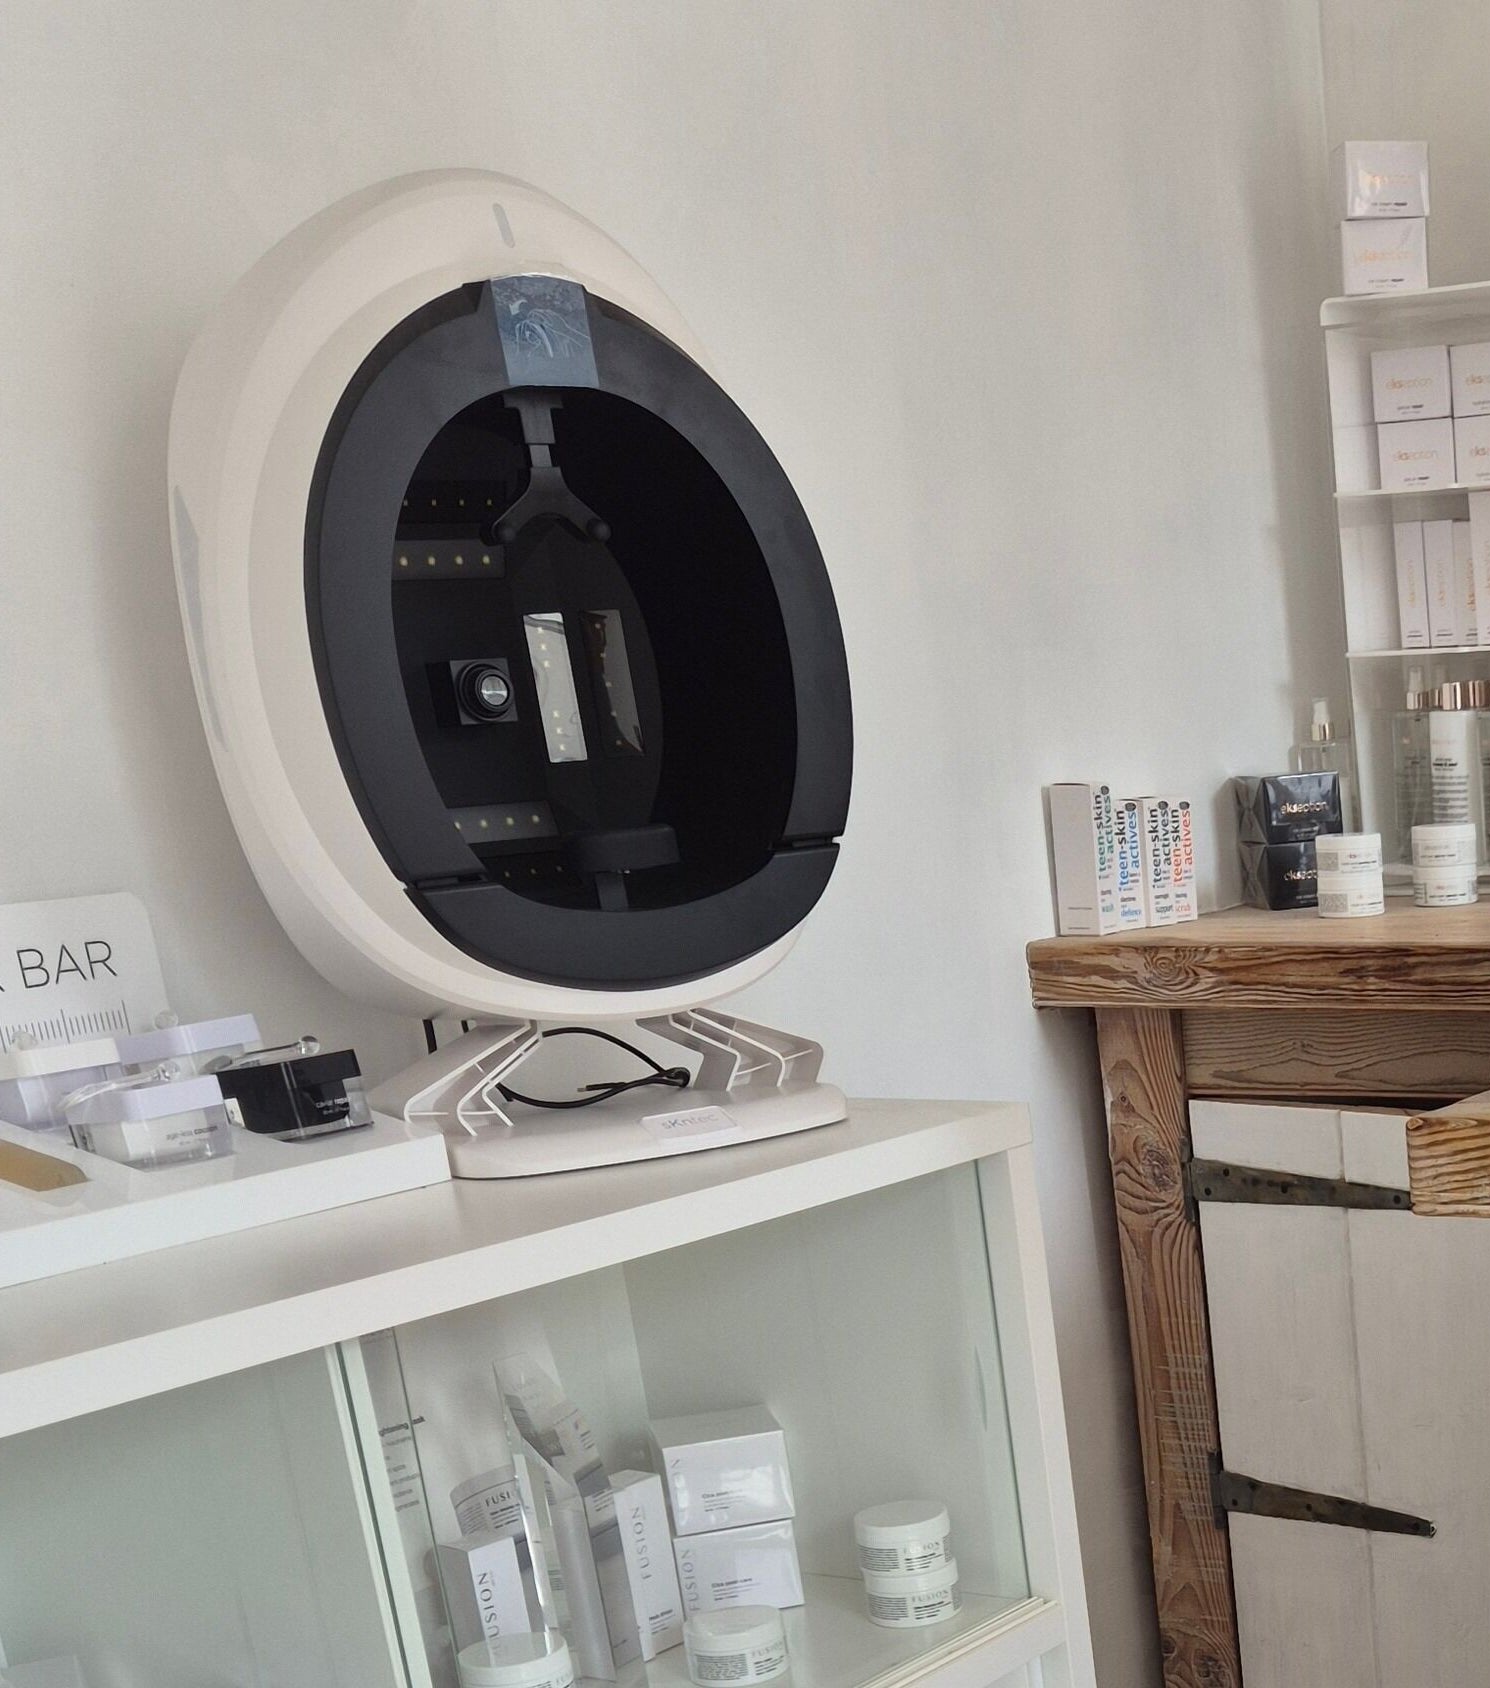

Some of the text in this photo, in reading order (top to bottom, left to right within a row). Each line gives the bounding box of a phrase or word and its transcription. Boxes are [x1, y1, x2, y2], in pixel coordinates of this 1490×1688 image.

[1103, 794, 1114, 854] actives
[1114, 810, 1129, 886] teen-skin
[1127, 810, 1140, 869] actives
[1148, 808, 1162, 883] teen-skin
[1158, 809, 1172, 866] actives
[1171, 809, 1183, 883] teen-skin
[1181, 809, 1193, 865] actives
[1284, 869, 1318, 881] eksept
[15, 939, 118, 989] BAR
[485, 1490, 511, 1507] FUSI
[681, 1548, 701, 1612] FUSION
